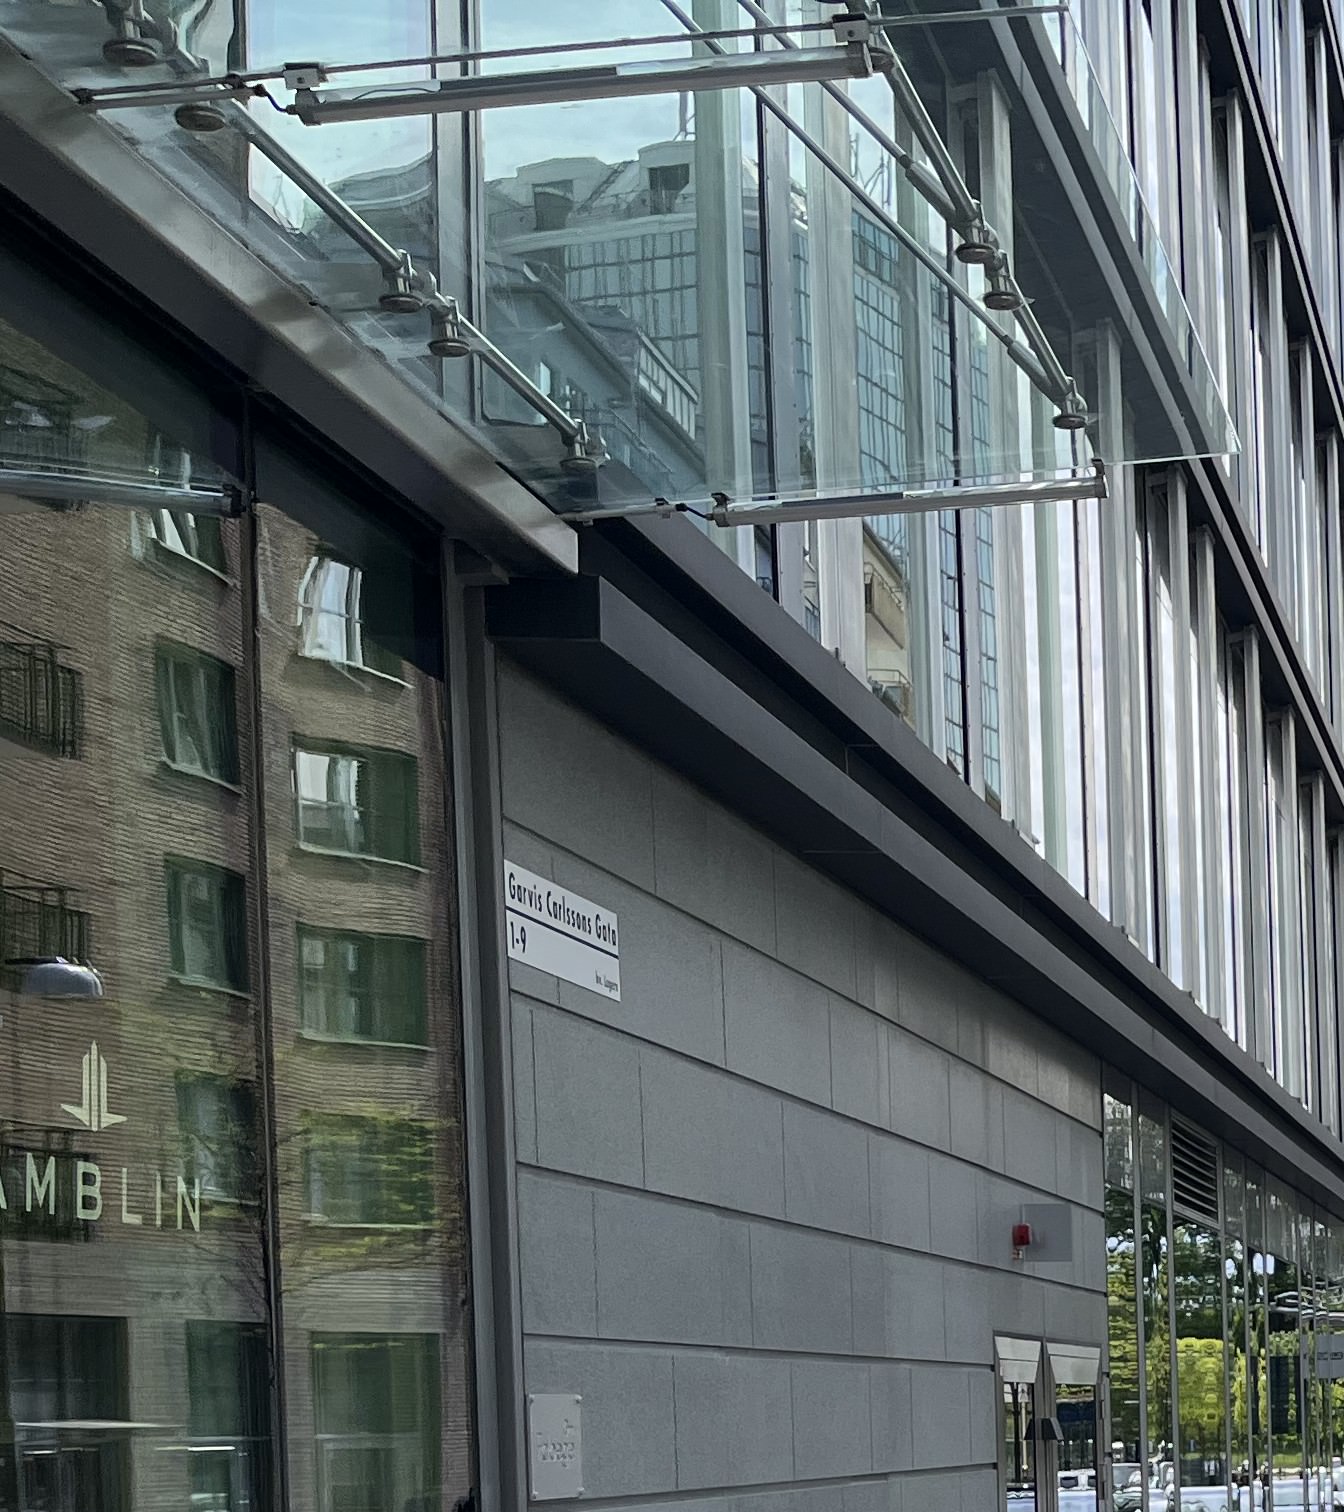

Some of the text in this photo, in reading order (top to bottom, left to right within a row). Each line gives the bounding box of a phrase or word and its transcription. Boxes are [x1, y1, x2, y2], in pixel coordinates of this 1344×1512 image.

[508, 871, 617, 946] Garvis Carlssons Gata
[509, 921, 527, 954] 1-9
